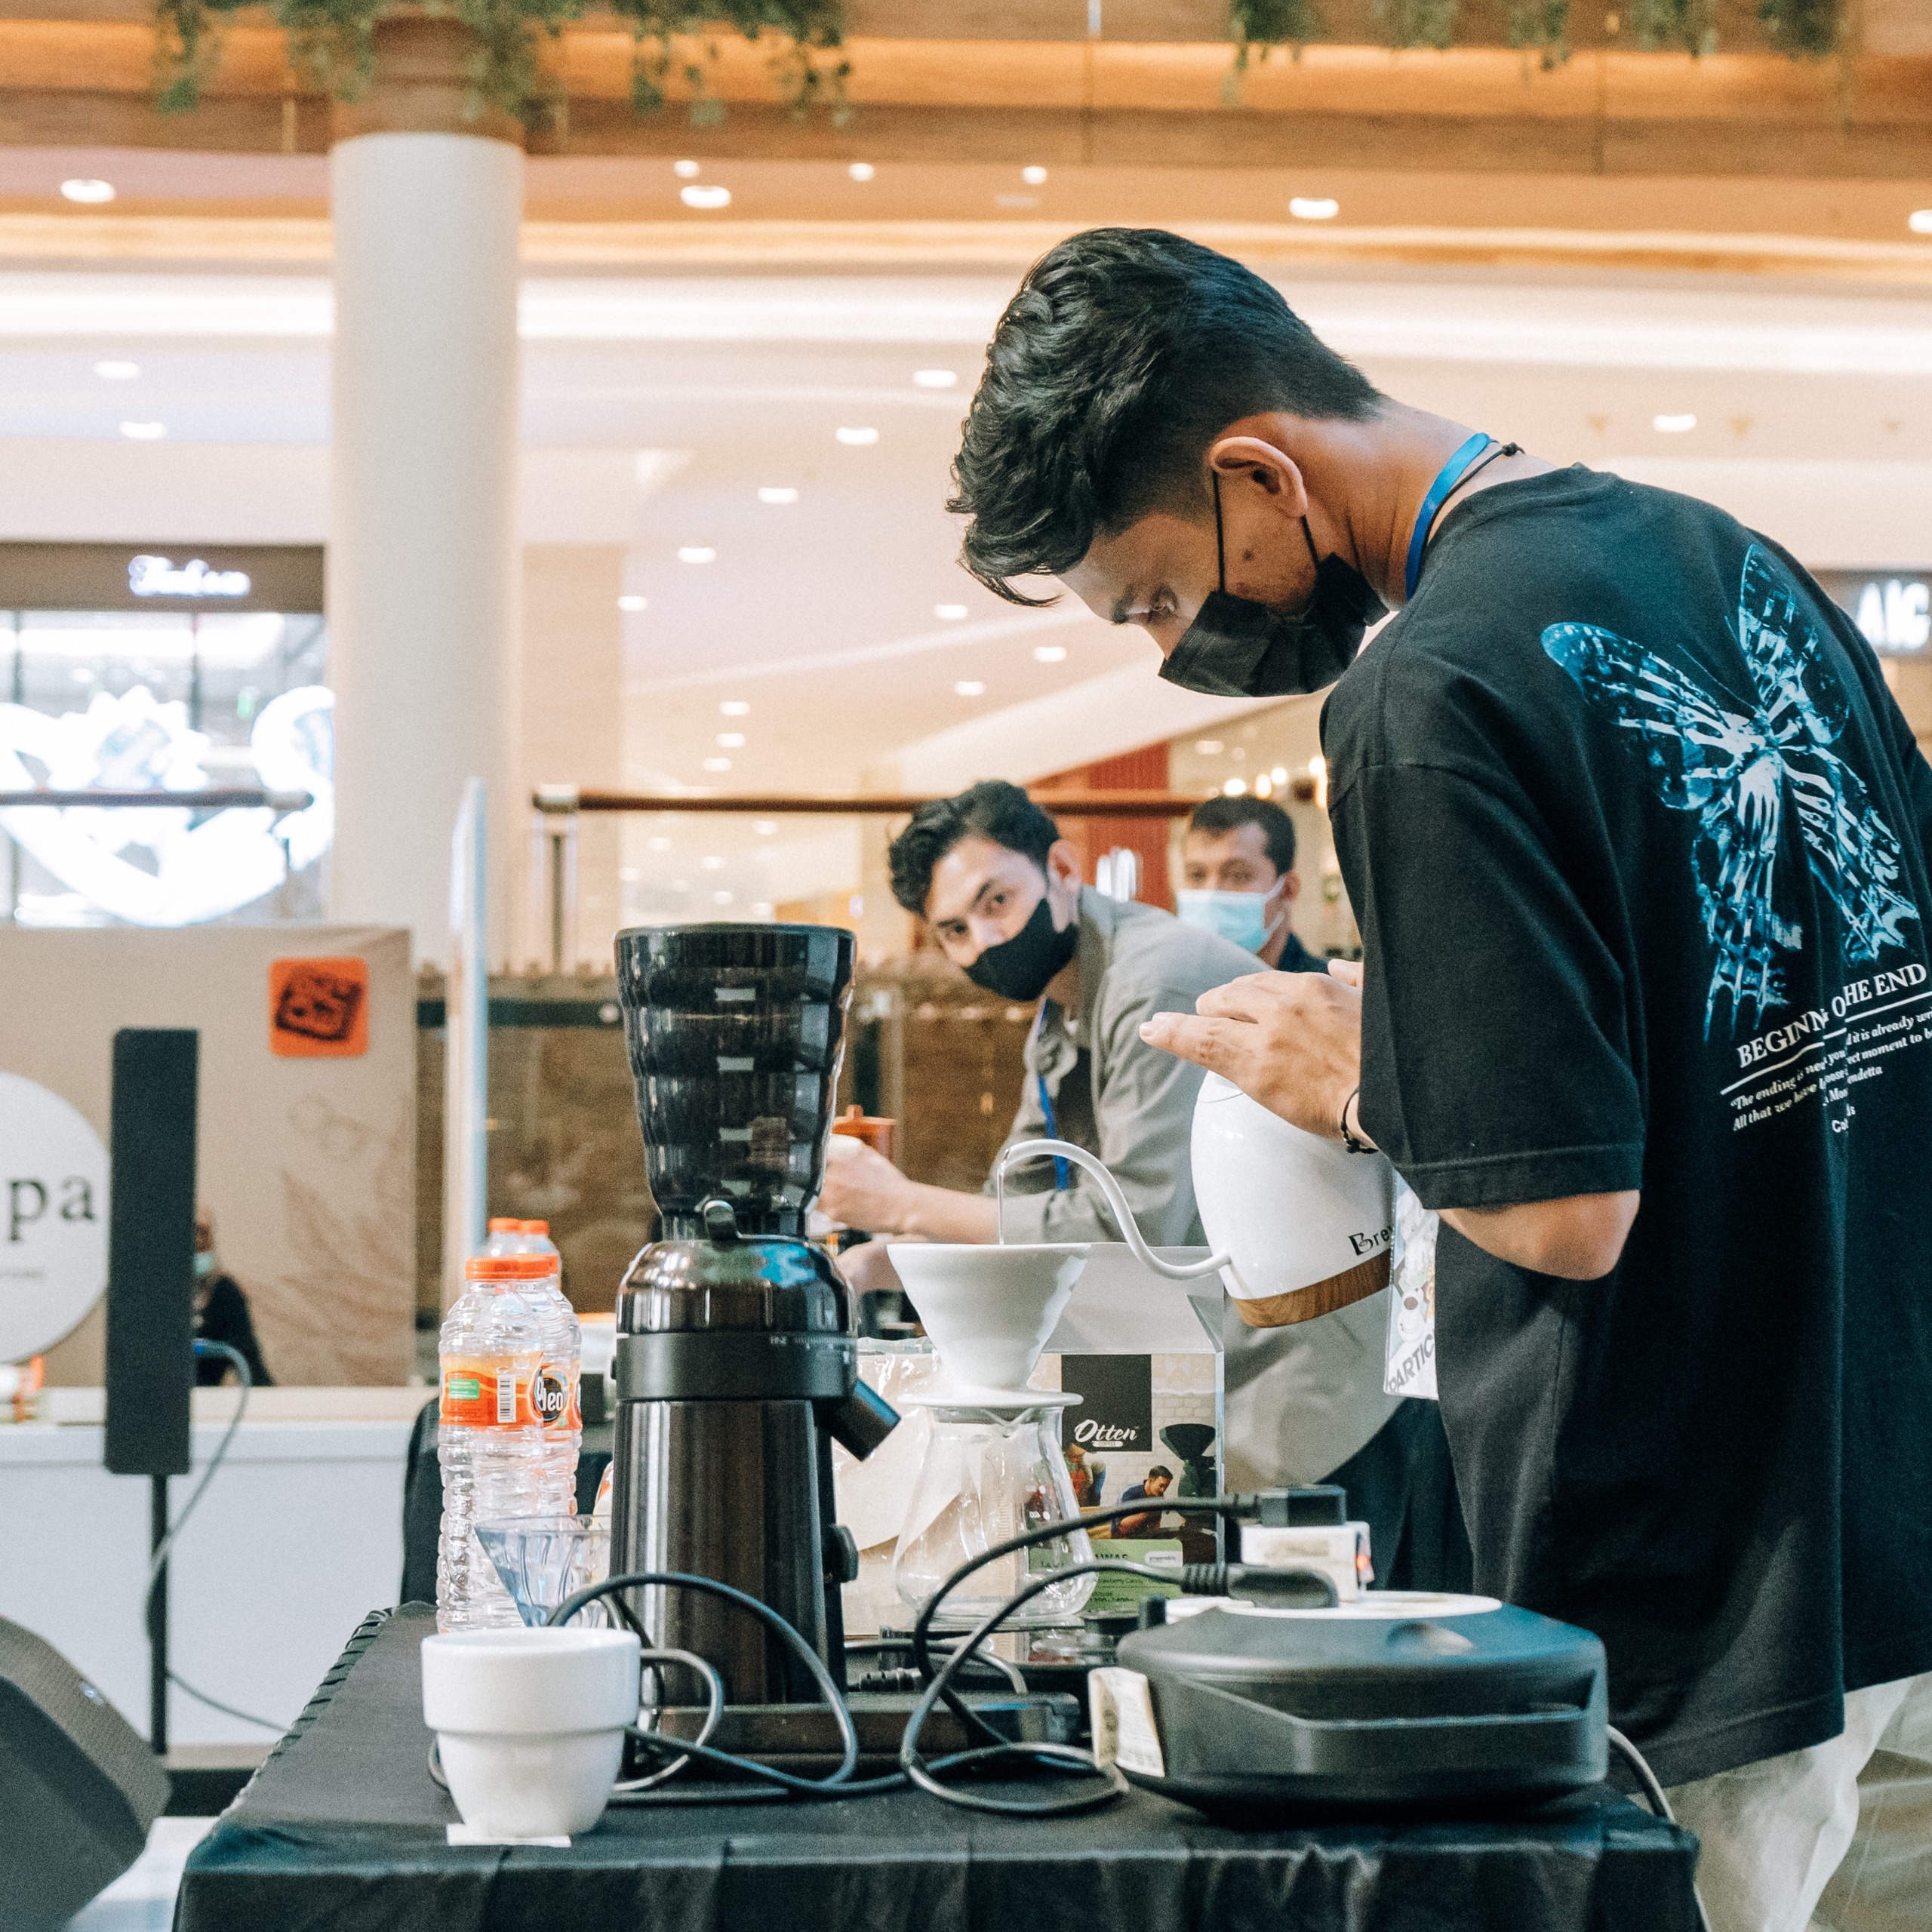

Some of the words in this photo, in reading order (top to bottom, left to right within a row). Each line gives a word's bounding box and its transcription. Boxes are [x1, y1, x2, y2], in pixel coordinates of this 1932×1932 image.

[1737, 1009, 1829, 1068] BEGINN
[1832, 996, 1846, 1018] O
[1843, 980, 1872, 1007] HE
[1874, 964, 1927, 996] END
[1733, 1114, 1748, 1131] All
[1749, 1106, 1772, 1124] that
[1861, 1037, 1908, 1060] moment
[1909, 1034, 1923, 1044] to
[1755, 1079, 1796, 1100] ending
[1860, 1029, 1870, 1041] is
[1872, 1015, 1915, 1038] already
[8, 1175, 96, 1242] pa
[1348, 1225, 1393, 1257] Bre
[1389, 1334, 1435, 1395] PARTIC
[1074, 1419, 1138, 1443] Otten
